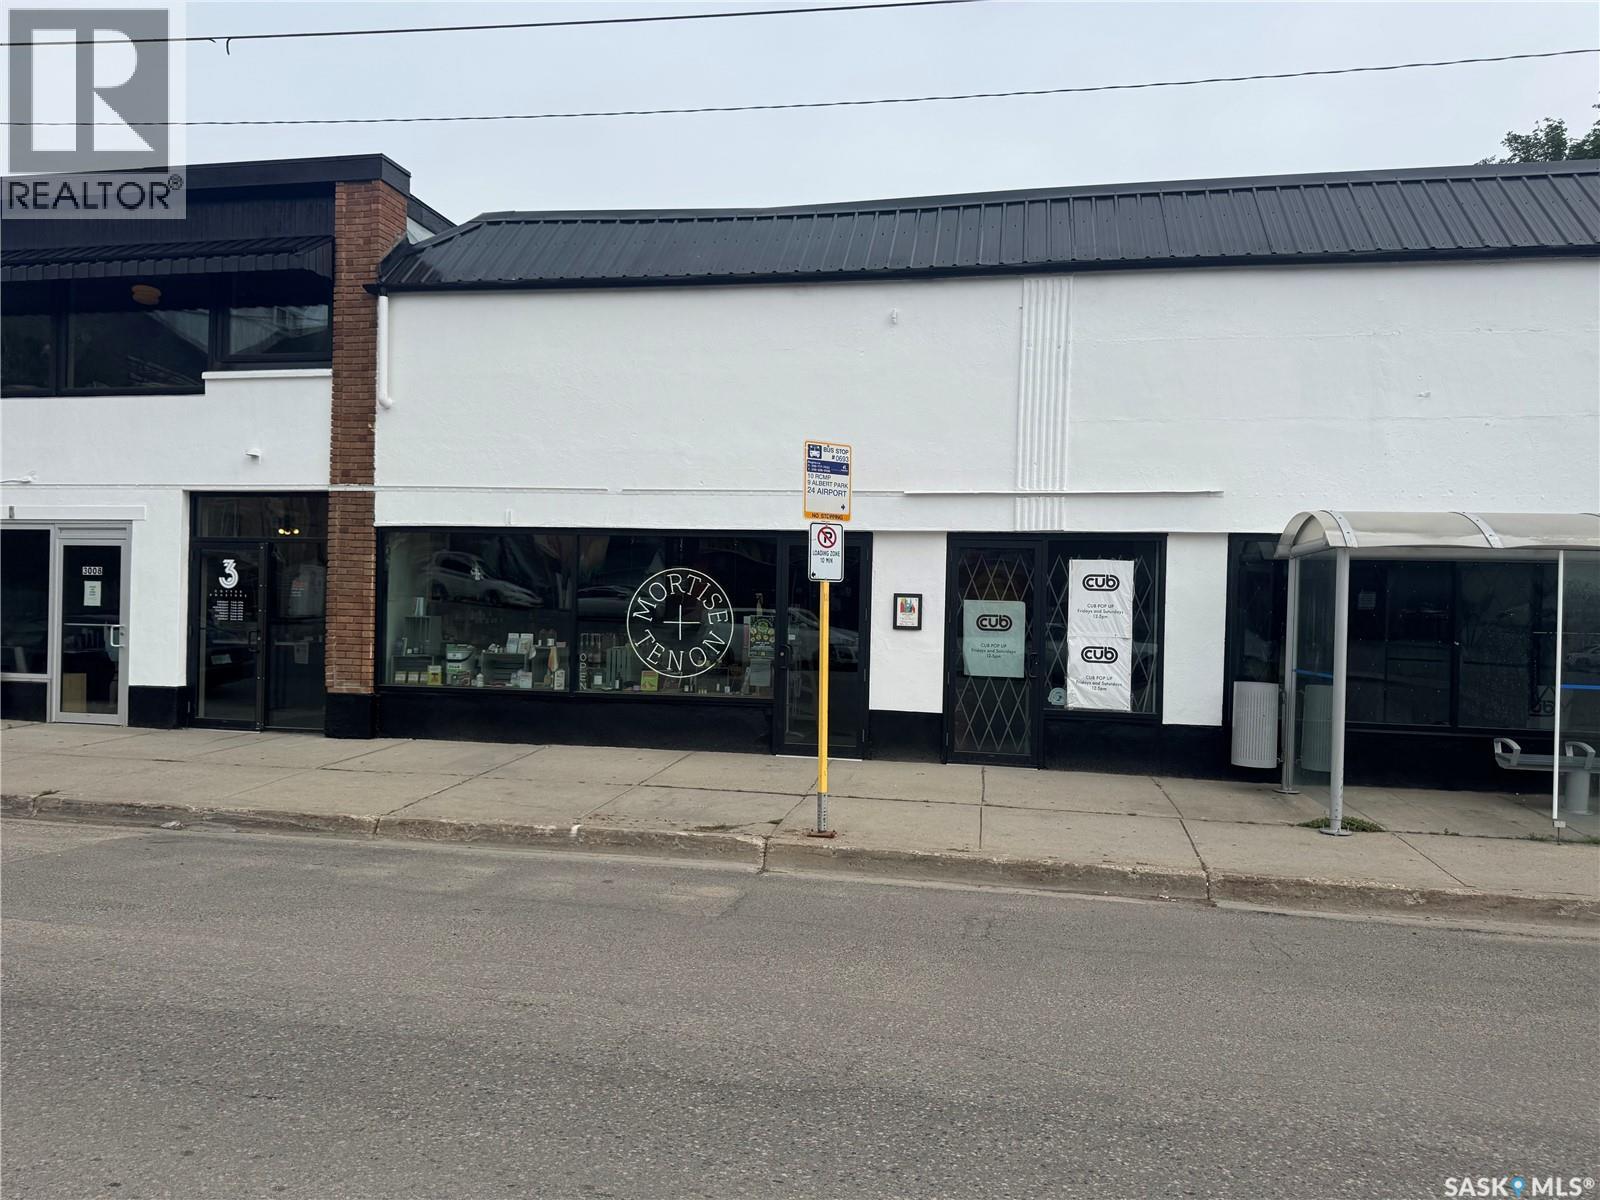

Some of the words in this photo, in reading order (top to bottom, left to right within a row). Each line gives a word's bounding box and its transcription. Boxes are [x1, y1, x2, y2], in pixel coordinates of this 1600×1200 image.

[817, 487, 847, 497] AIRPORT
[219, 559, 239, 589] 3
[632, 573, 728, 625] MORTISE
[635, 629, 726, 672] TENON
[579, 652, 587, 691] OPEN
